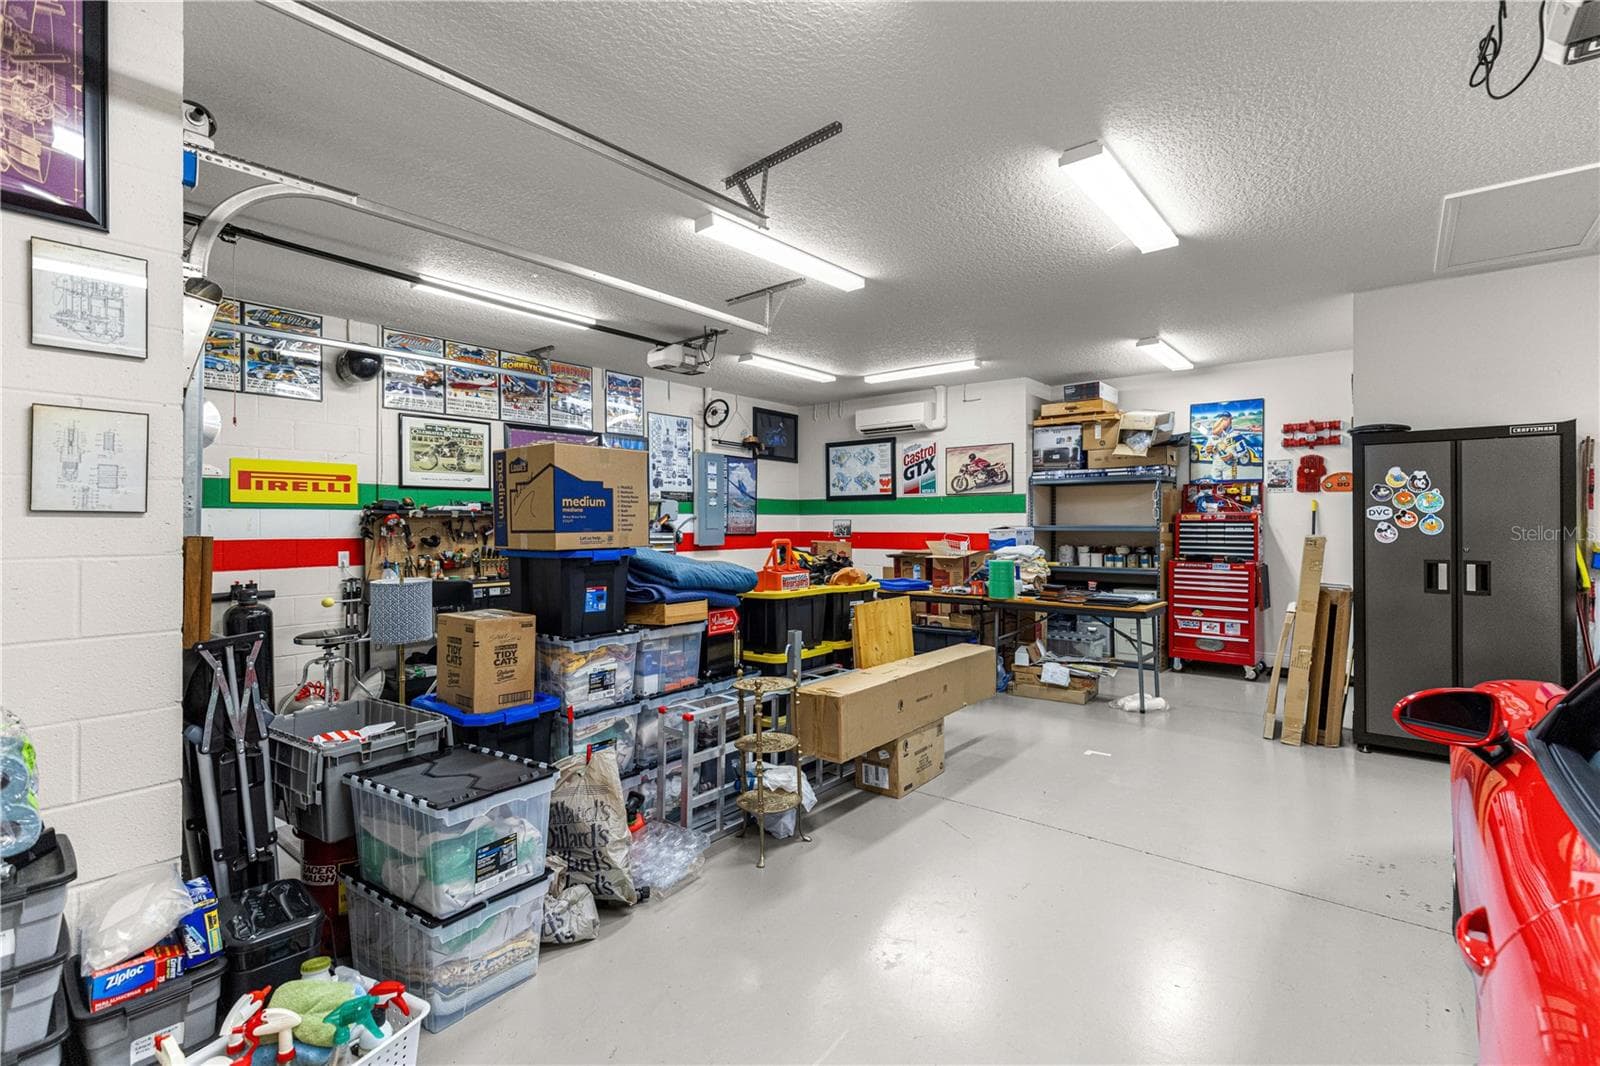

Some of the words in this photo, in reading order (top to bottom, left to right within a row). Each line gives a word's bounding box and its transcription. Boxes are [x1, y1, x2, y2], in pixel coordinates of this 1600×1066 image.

[1512, 425, 1554, 433] CRAFTSMAN
[903, 442, 937, 466] Castrol
[903, 455, 936, 481] GTX
[237, 470, 352, 493] PIRELLI
[497, 459, 506, 519] medium
[561, 495, 606, 507] medium
[446, 644, 462, 655] TIDY
[494, 650, 517, 659] TIDY
[446, 654, 463, 666] CATS
[493, 656, 518, 666] CATS
[105, 965, 145, 990] Ziploc
